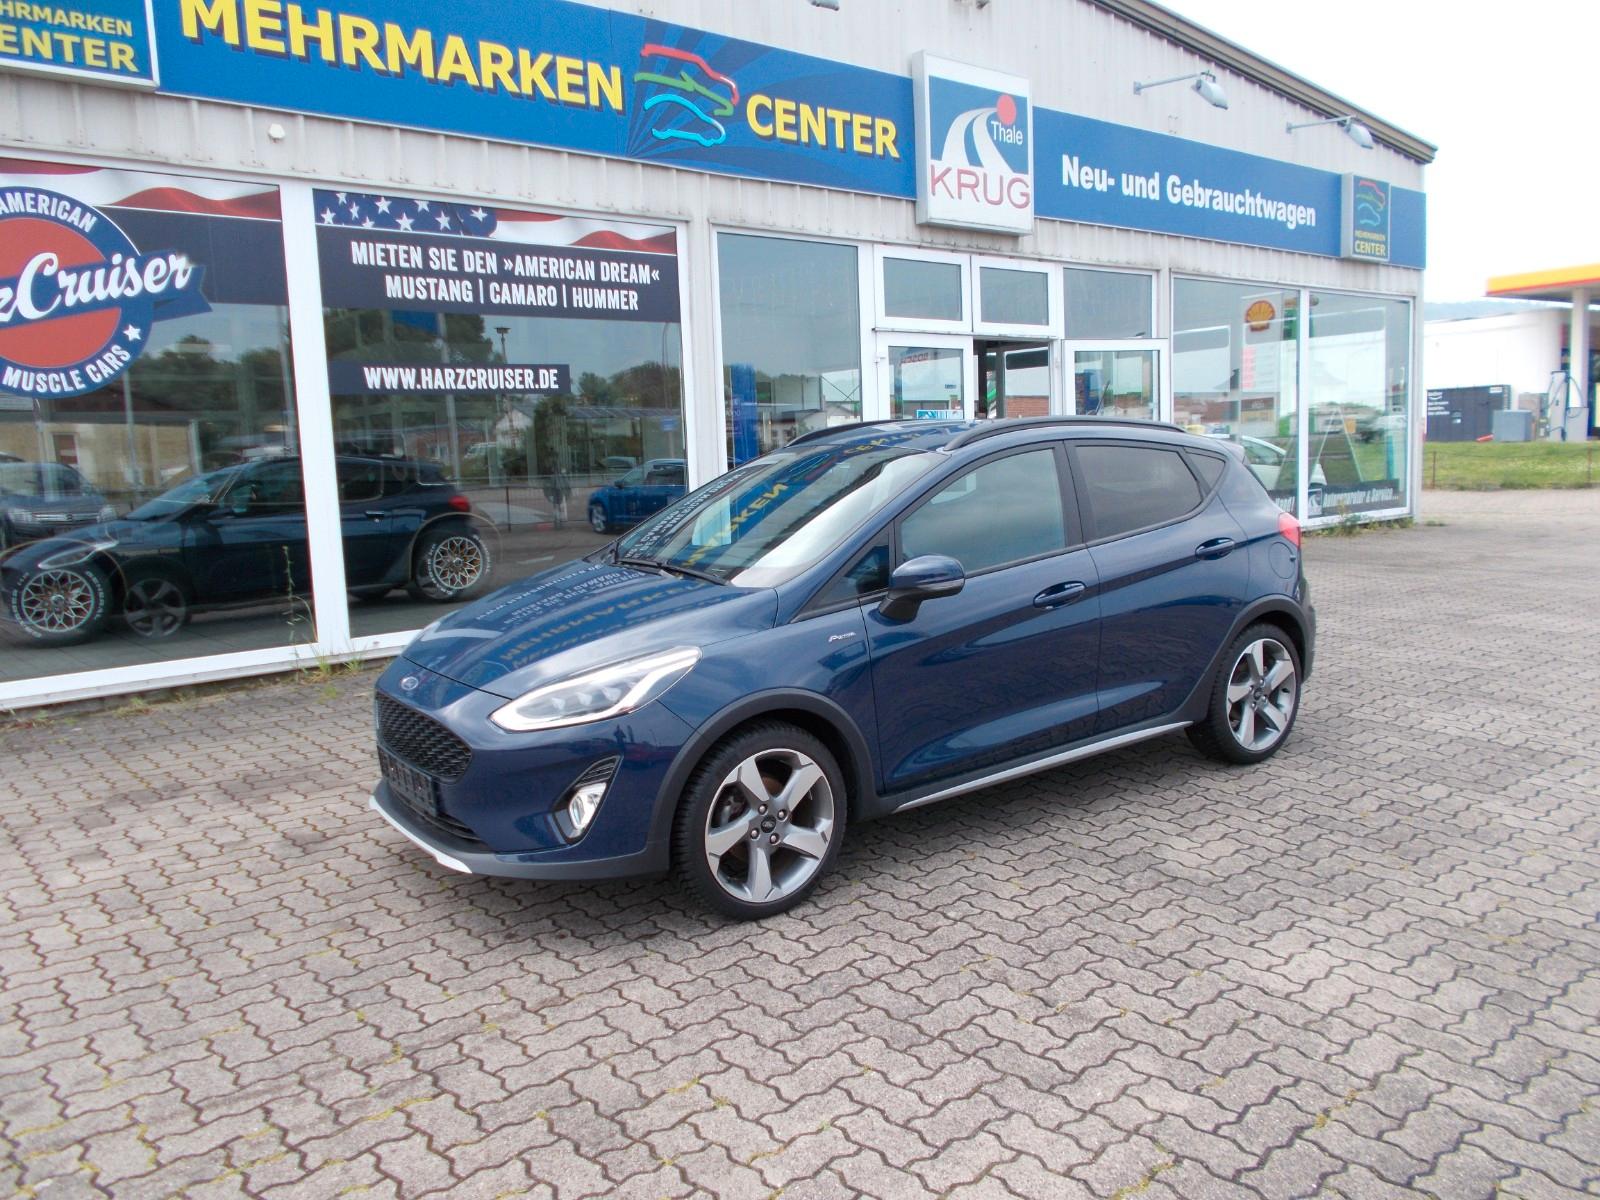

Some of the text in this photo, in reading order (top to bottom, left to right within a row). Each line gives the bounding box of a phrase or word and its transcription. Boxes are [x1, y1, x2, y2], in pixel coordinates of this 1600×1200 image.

[180, 0, 623, 111] MEHRMARKEN
[746, 94, 900, 159] CENTER
[991, 120, 1024, 145] Thale
[930, 164, 1031, 209] KRUG
[1062, 154, 1316, 230] Neu- und Gebrauchtwagen
[351, 241, 423, 269] MIETEN
[428, 246, 459, 272] SIE
[462, 250, 498, 275] DEN
[385, 275, 473, 303] MUSTANG
[489, 281, 557, 307] CAMARO
[572, 287, 639, 311] HUMMER
[3, 344, 131, 393] MUSCLE CARS
[363, 366, 559, 390] WWW.HARZCRUISER.DE
